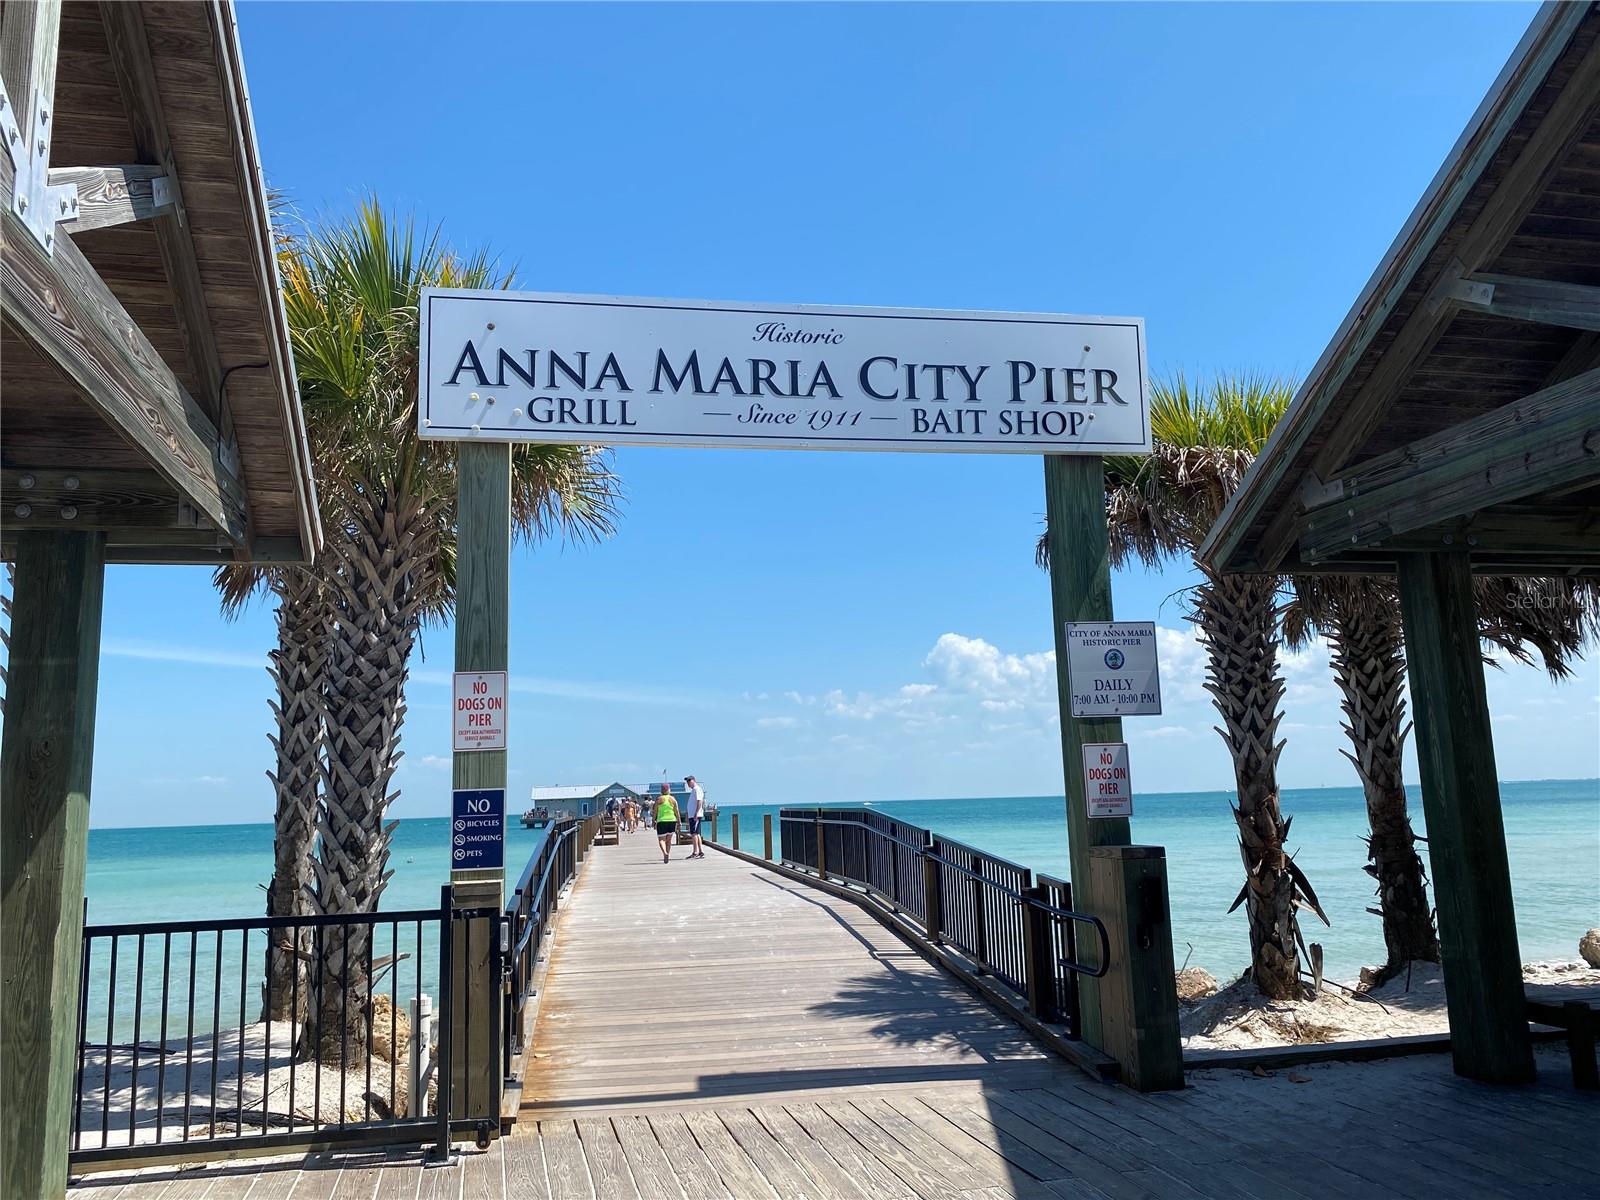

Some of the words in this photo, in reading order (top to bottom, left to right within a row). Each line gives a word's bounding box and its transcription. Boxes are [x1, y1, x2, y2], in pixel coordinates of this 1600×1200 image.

[752, 321, 845, 345] Historic
[442, 339, 633, 393] ANNA
[647, 347, 843, 399] MARIA
[858, 356, 990, 402] CITY
[1005, 360, 1128, 405] PIER
[527, 396, 637, 426] GRILL
[737, 403, 798, 424] Since
[806, 409, 862, 430] 1911
[912, 408, 987, 435] BAIT
[999, 410, 1085, 436] SHOP
[1123, 638, 1141, 646] PIER
[473, 681, 488, 694] NO
[1094, 679, 1134, 691] DAILY
[458, 698, 485, 711] DOGS
[487, 697, 502, 710] ON
[1074, 695, 1091, 705] 7:00
[1094, 694, 1109, 704] AM
[1118, 693, 1138, 704] 10:00
[1140, 693, 1156, 703] PM
[468, 713, 492, 726] PIER
[1100, 753, 1113, 765] NO
[1089, 768, 1112, 780] DOGS
[1114, 767, 1126, 779] ON
[1099, 783, 1119, 795] PIER
[467, 798, 491, 814] NO
[467, 819, 500, 828] BICYCLES
[466, 834, 502, 843] SMOKING
[466, 849, 483, 858] PETS
